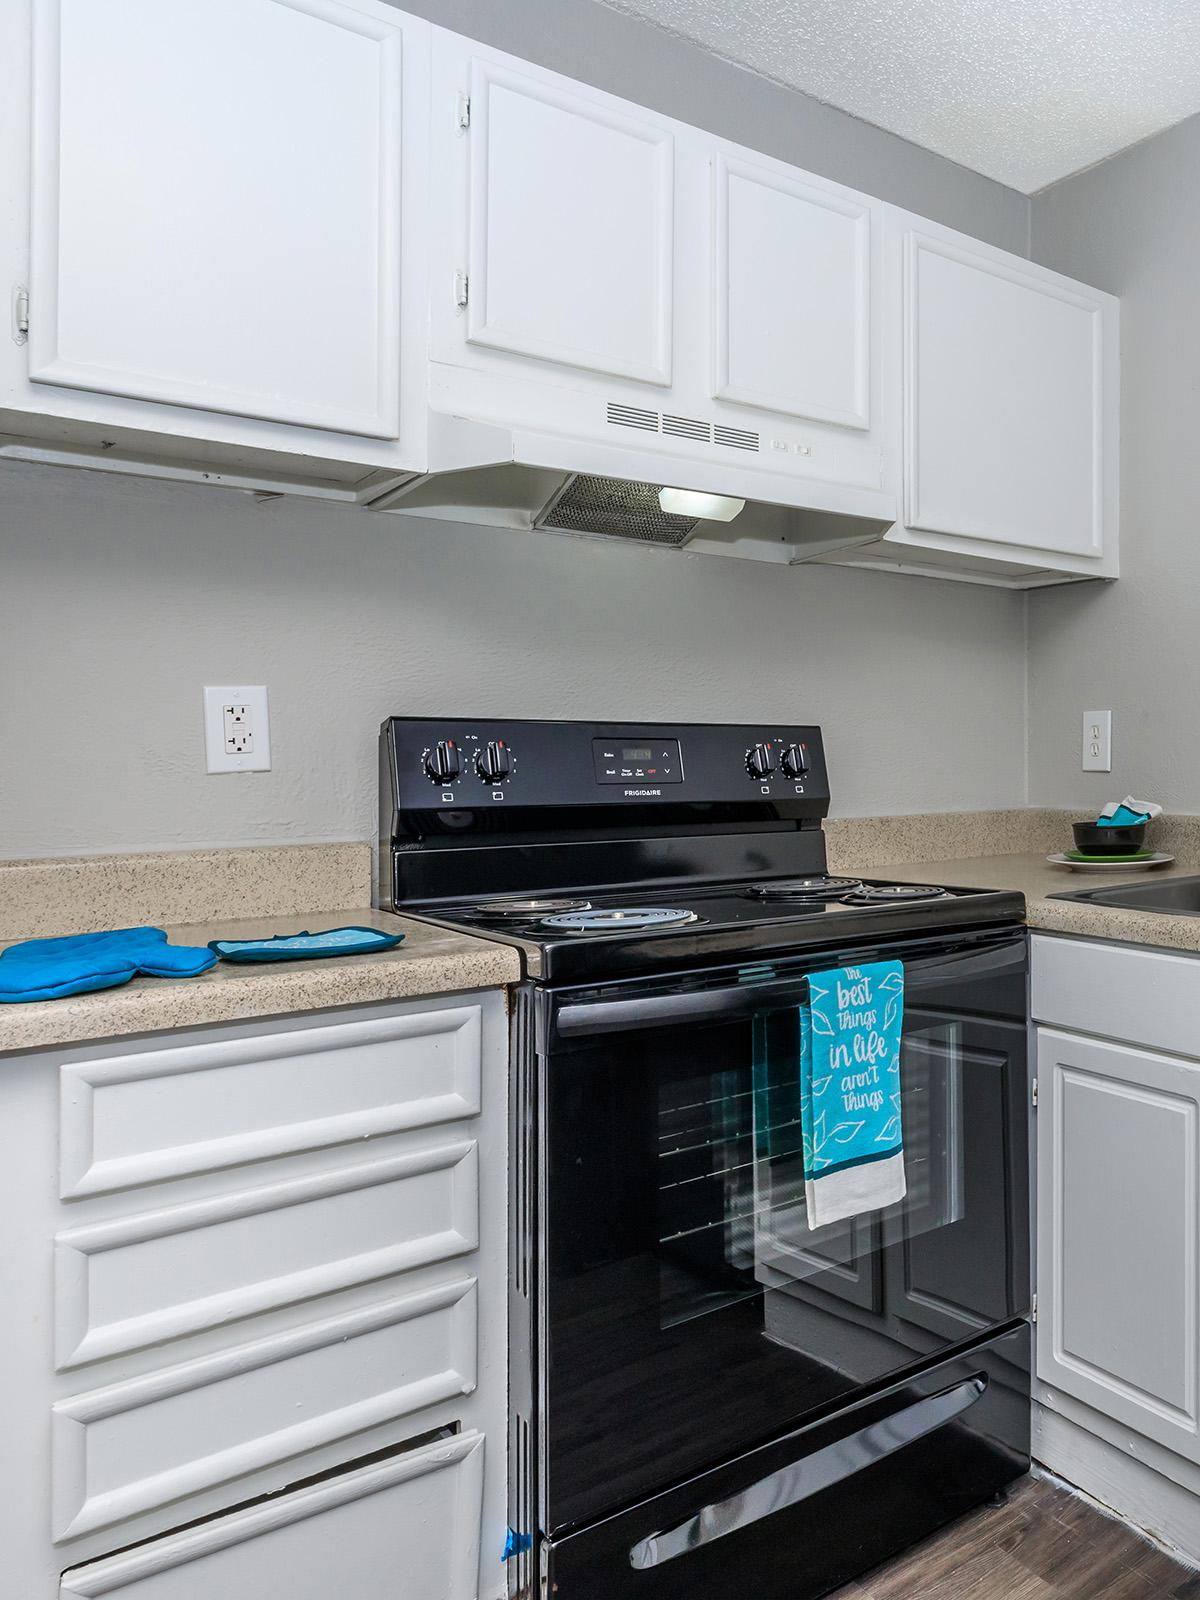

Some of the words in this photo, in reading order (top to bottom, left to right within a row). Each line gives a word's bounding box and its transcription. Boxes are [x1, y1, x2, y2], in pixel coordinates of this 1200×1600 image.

[837, 977, 873, 1011] best
[829, 1043, 851, 1069] in
[853, 1031, 888, 1066] life
[841, 1066, 880, 1092] aren't
